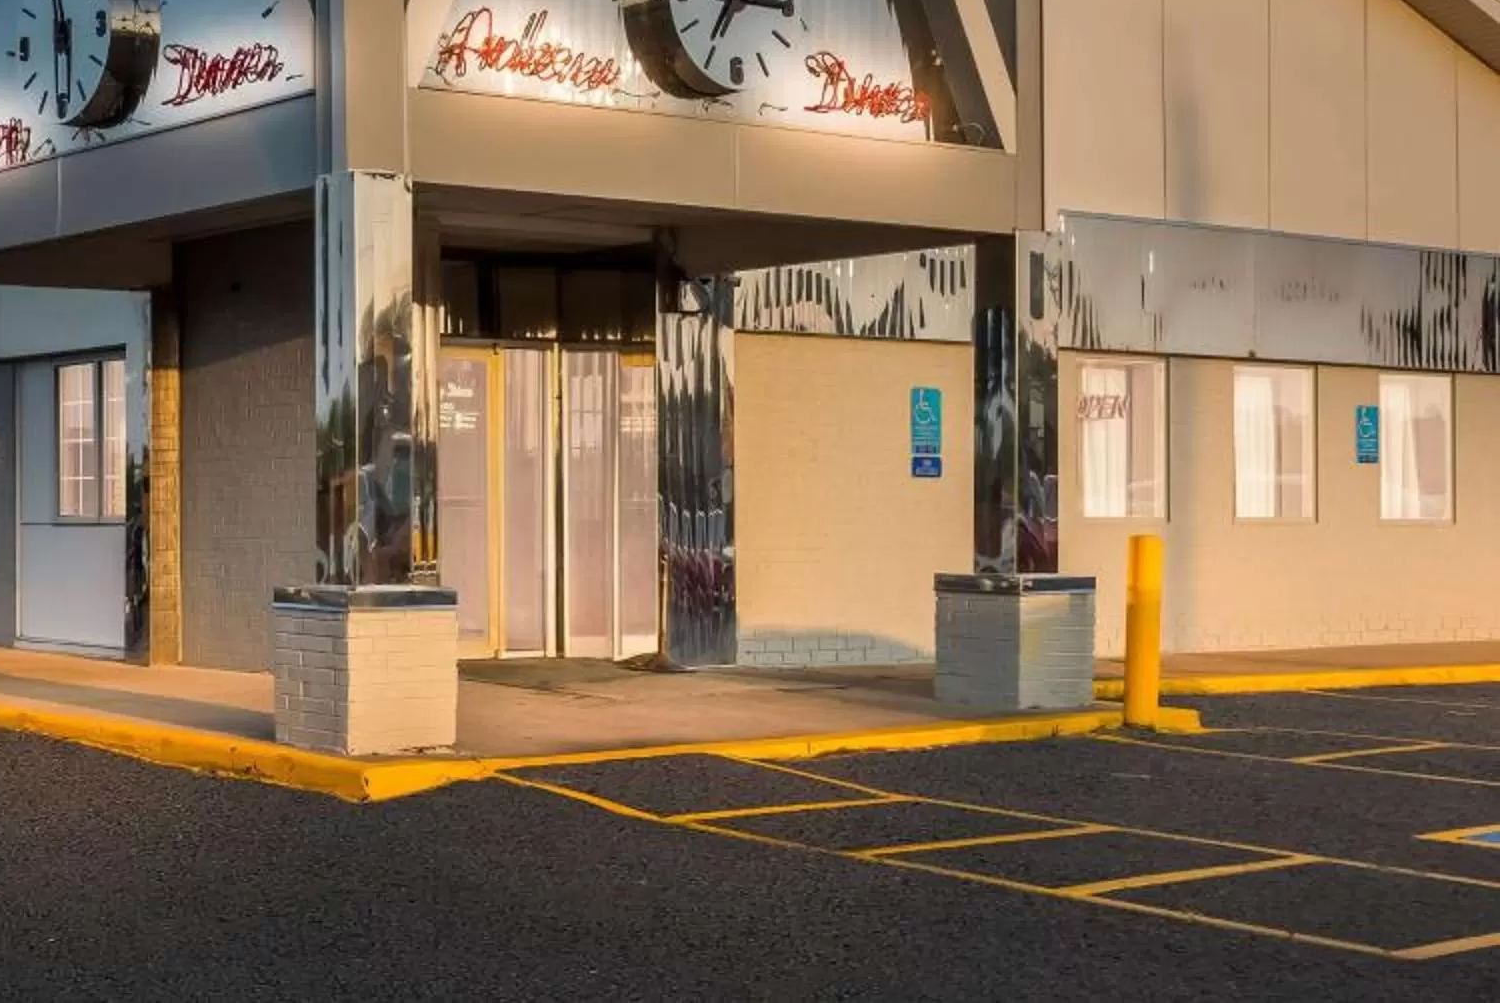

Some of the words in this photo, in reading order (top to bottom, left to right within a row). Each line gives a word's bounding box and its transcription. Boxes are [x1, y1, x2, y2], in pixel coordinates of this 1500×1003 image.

[95, 10, 107, 38] 3
[19, 36, 31, 62] 9
[729, 56, 745, 86] 6
